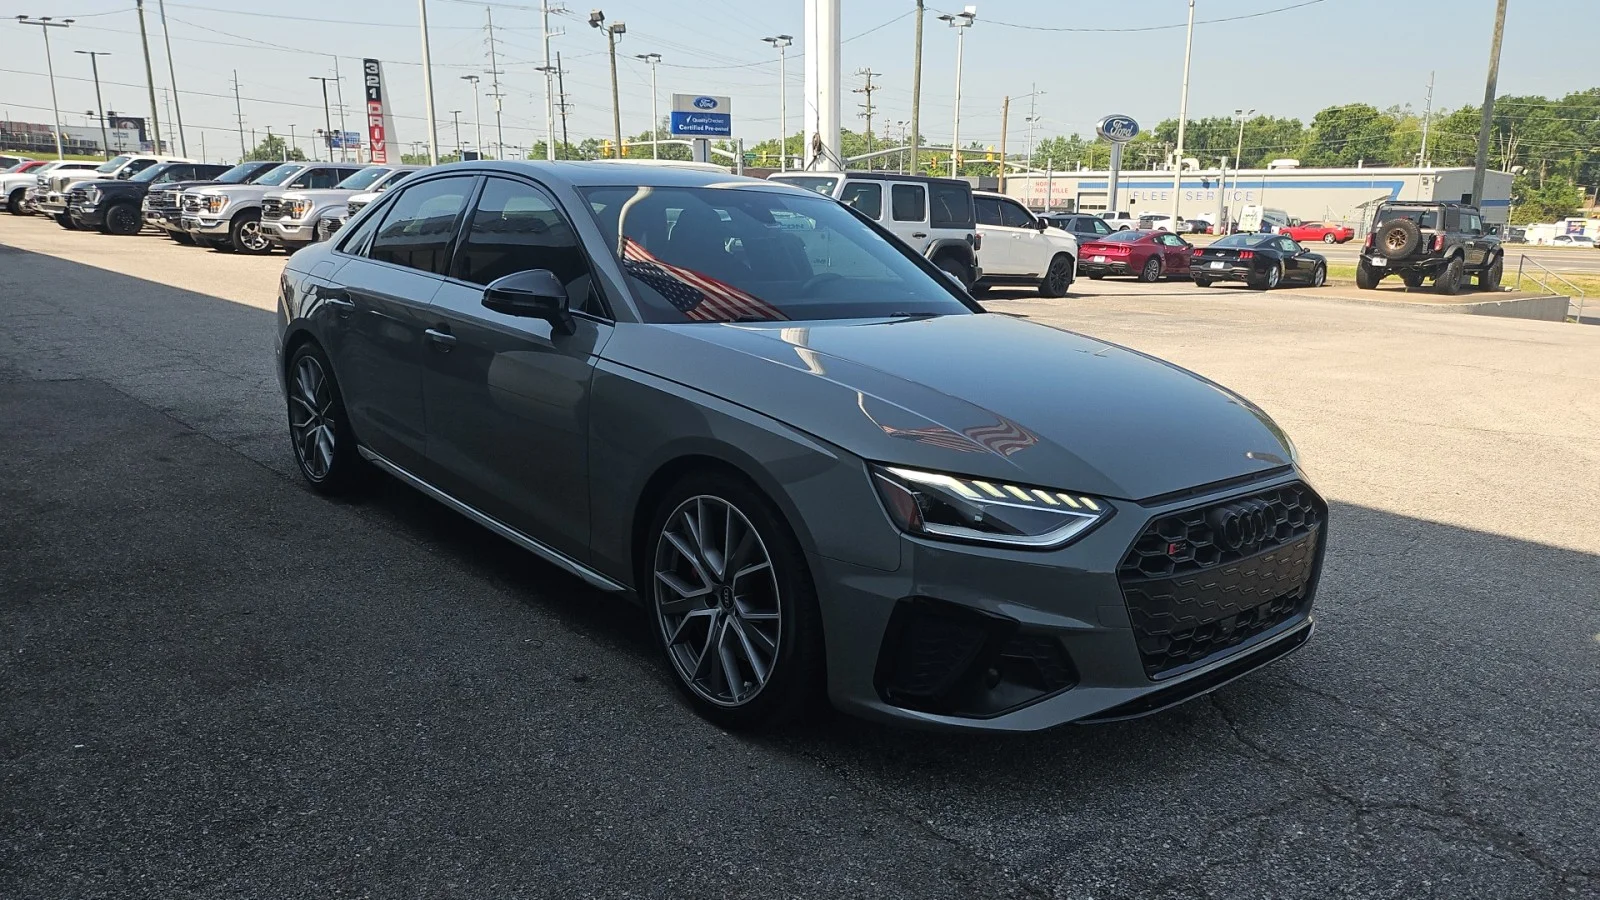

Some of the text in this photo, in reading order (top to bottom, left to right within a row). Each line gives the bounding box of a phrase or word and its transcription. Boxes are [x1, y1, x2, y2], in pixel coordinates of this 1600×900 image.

[699, 99, 714, 108] Ford
[365, 62, 386, 162] 321 DRIVE
[1110, 119, 1134, 138] Ford
[1133, 191, 1253, 201] FLEE SERICE
